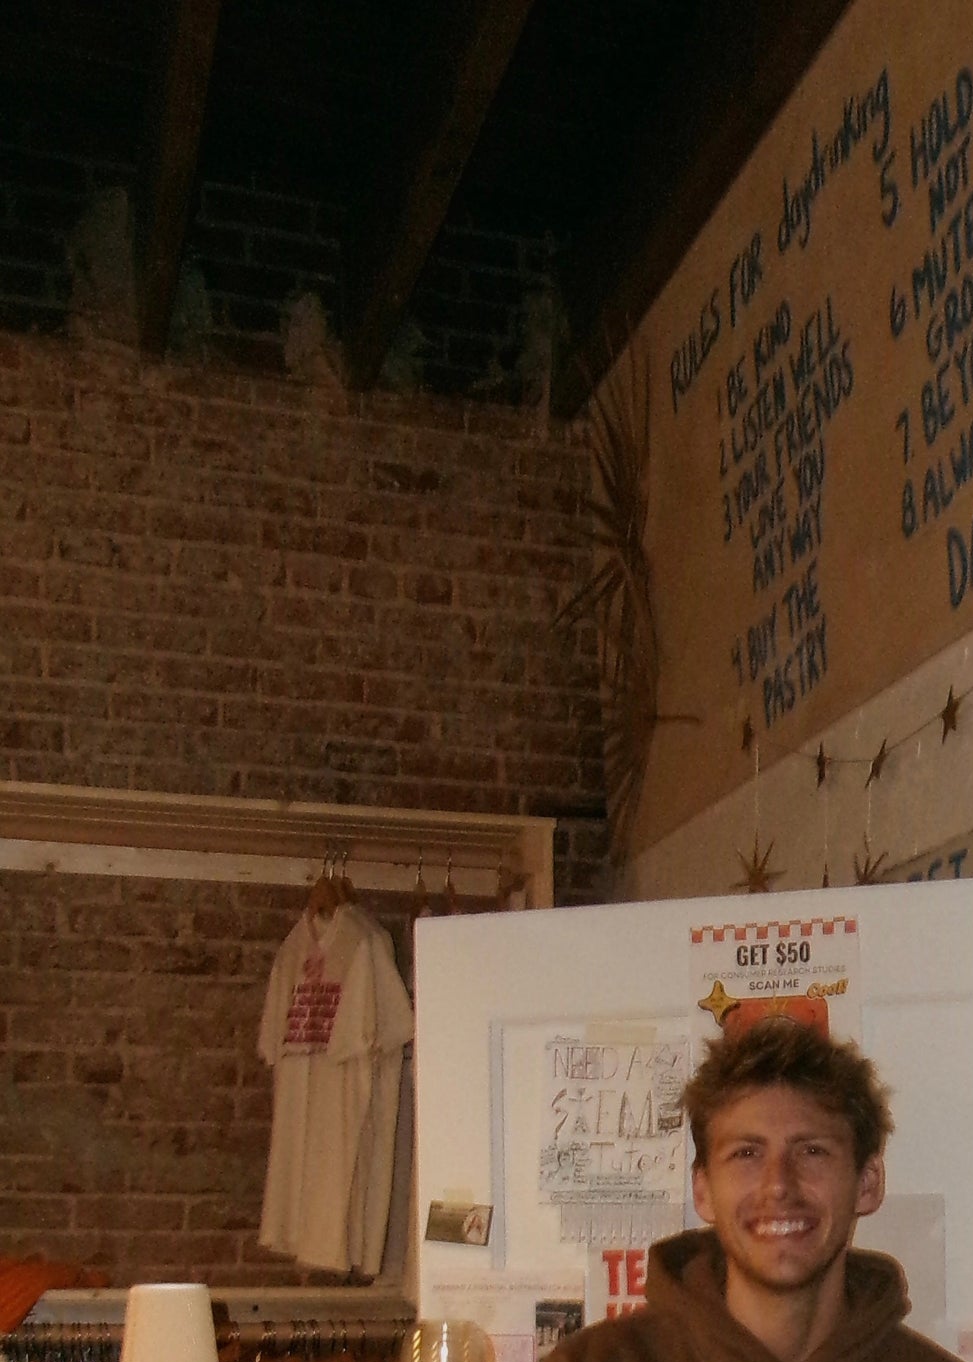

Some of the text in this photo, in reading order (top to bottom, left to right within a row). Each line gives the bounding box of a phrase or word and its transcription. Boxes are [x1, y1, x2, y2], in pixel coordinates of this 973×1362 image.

[880, 151, 899, 229] 5
[910, 68, 973, 190] HOLD
[929, 131, 971, 234] NOT
[670, 287, 721, 414] RULES
[729, 231, 763, 329] FOR
[727, 353, 749, 420] BE
[753, 300, 792, 390] KIND
[889, 282, 907, 339] 6
[731, 366, 786, 465] LISTEN
[788, 294, 841, 392] WELL
[773, 338, 855, 480] FRIENDS
[793, 432, 825, 504] YOU
[747, 601, 778, 684] BUY
[781, 557, 820, 642] THE
[763, 611, 828, 731] PASTRY
[736, 940, 811, 967] GET $50
[749, 978, 800, 991] SCAN ME
[553, 1047, 619, 1080] NEED
